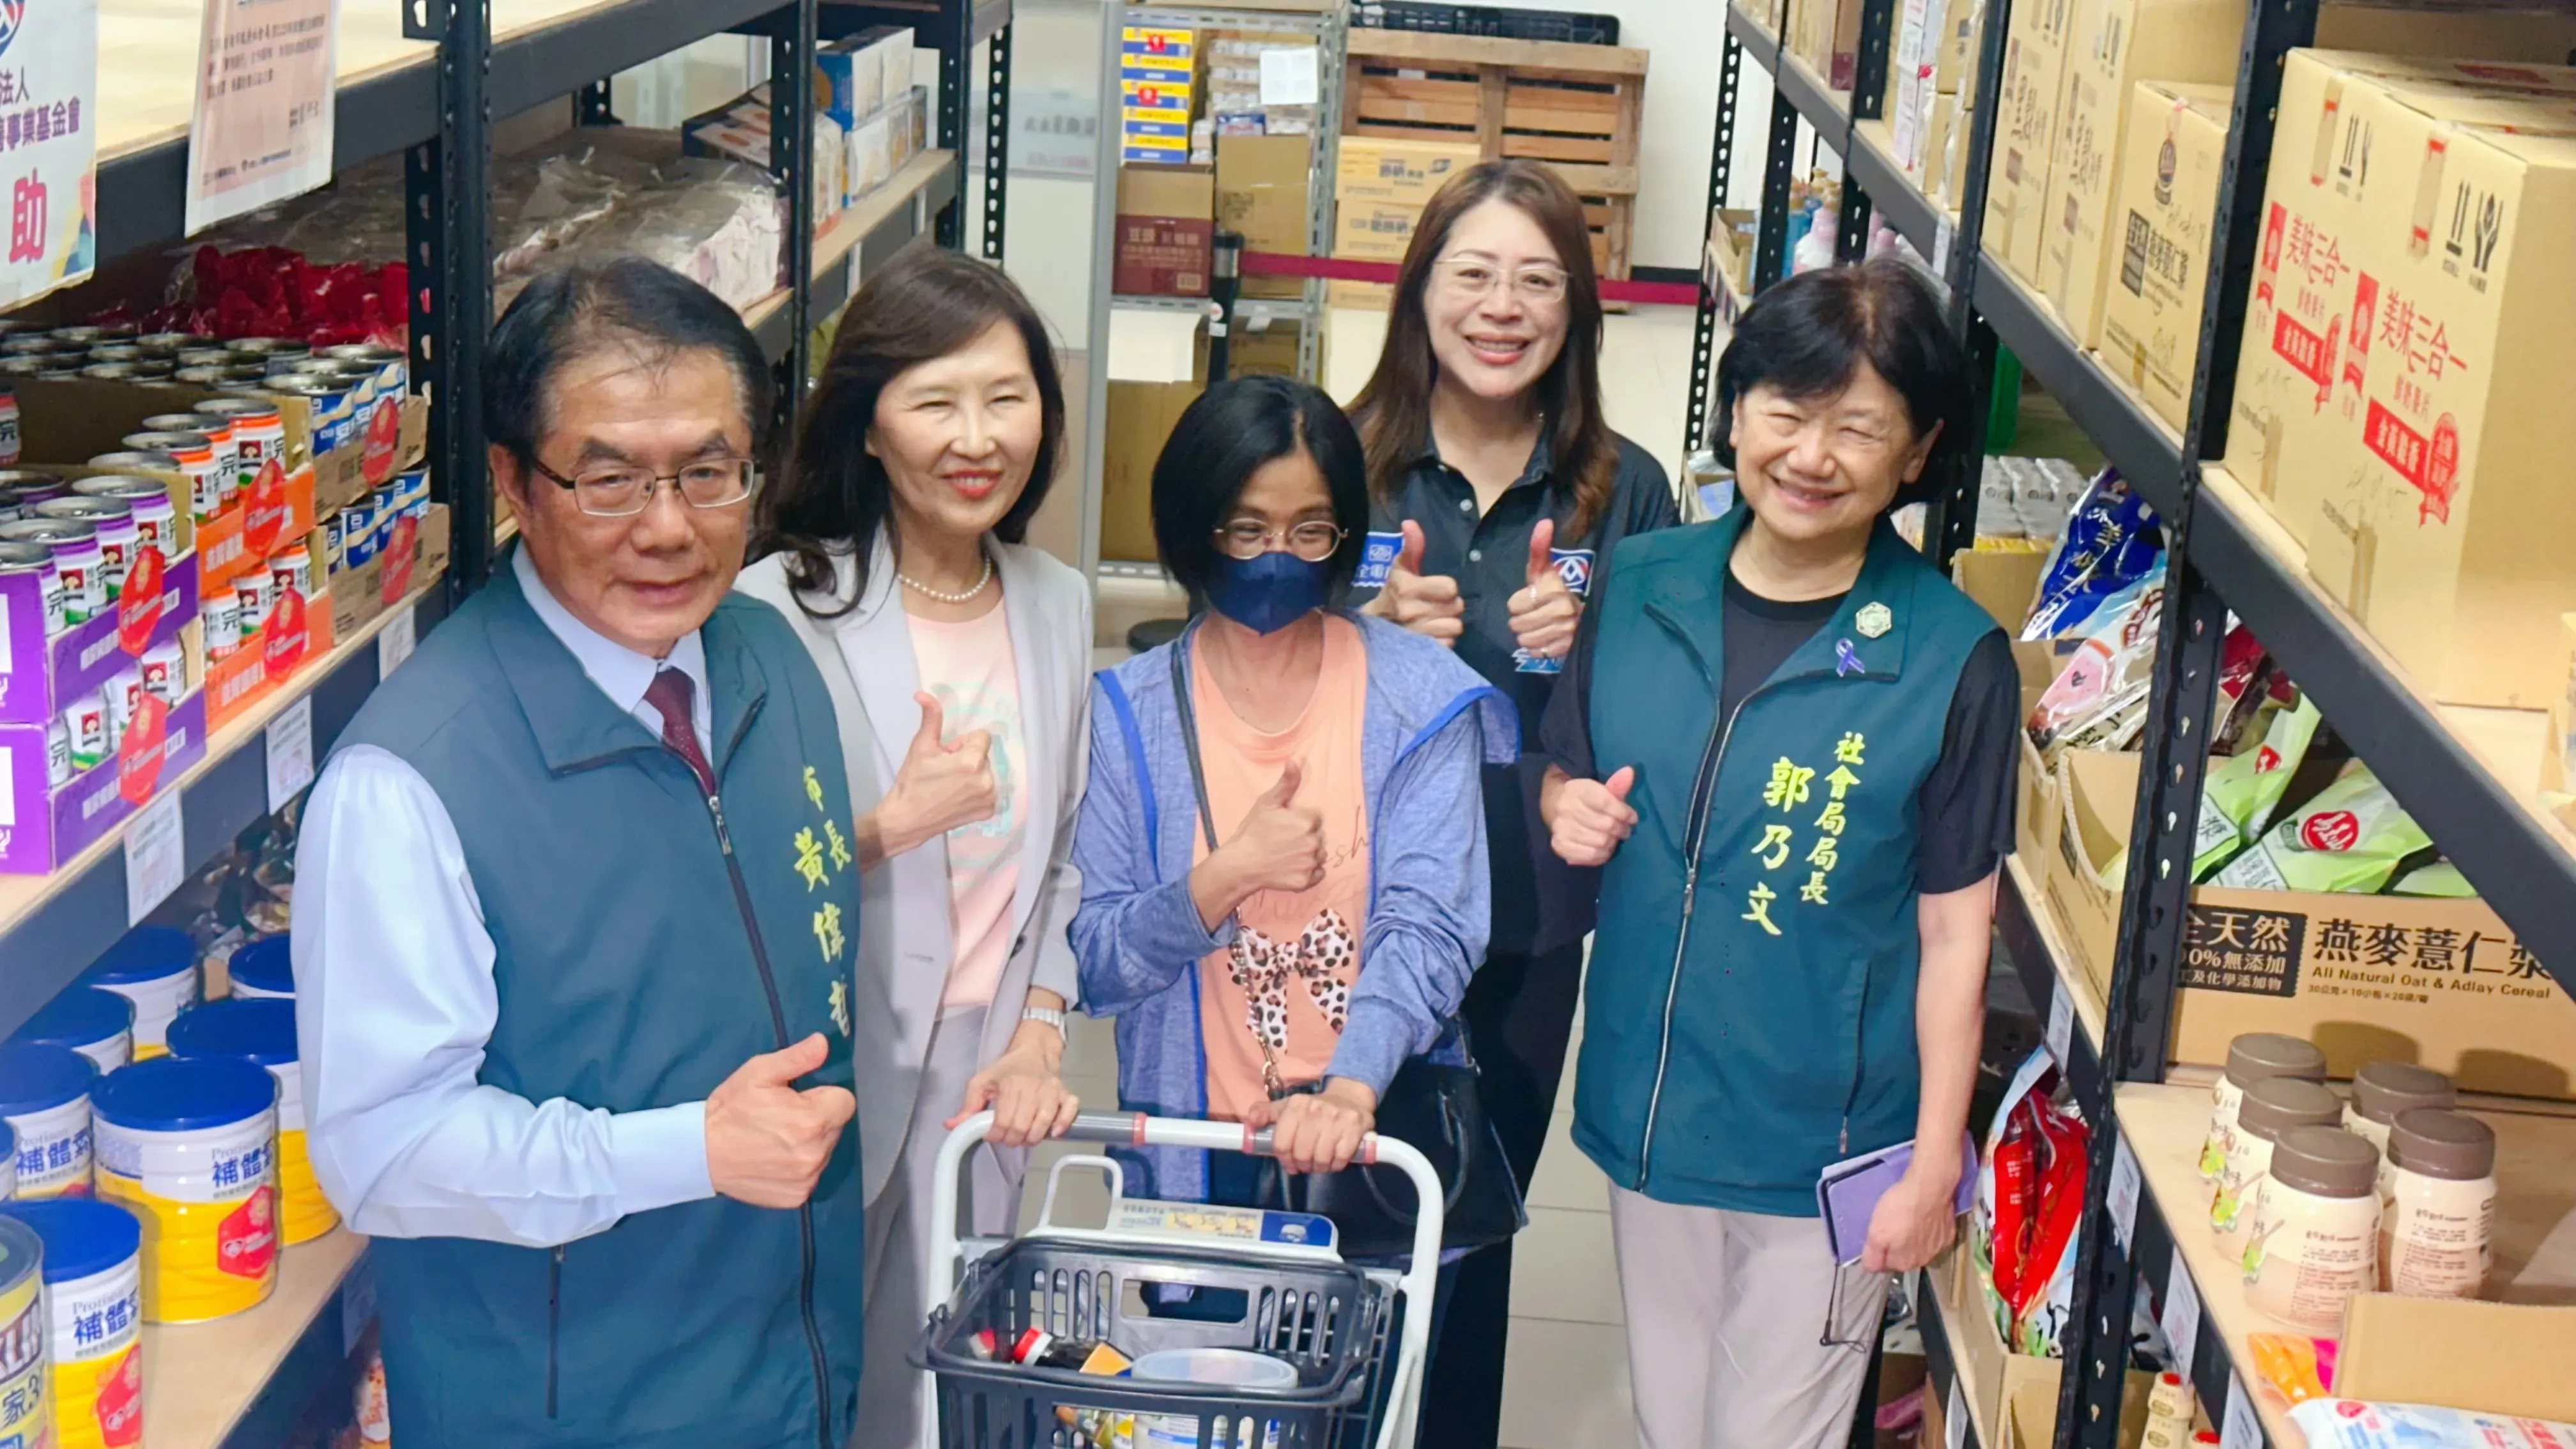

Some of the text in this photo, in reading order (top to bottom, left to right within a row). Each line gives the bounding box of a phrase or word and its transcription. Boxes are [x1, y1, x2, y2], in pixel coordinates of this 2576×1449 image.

[0, 96, 80, 153] 事業基金會
[9, 167, 47, 264] 助
[2379, 288, 2468, 381] 美味三合一
[803, 765, 852, 873] 市長
[1741, 756, 1815, 936] 郭乃文
[1800, 731, 1866, 905] 社會局局長
[2312, 965, 2551, 999] All Natural Oat & Adlay Cereal
